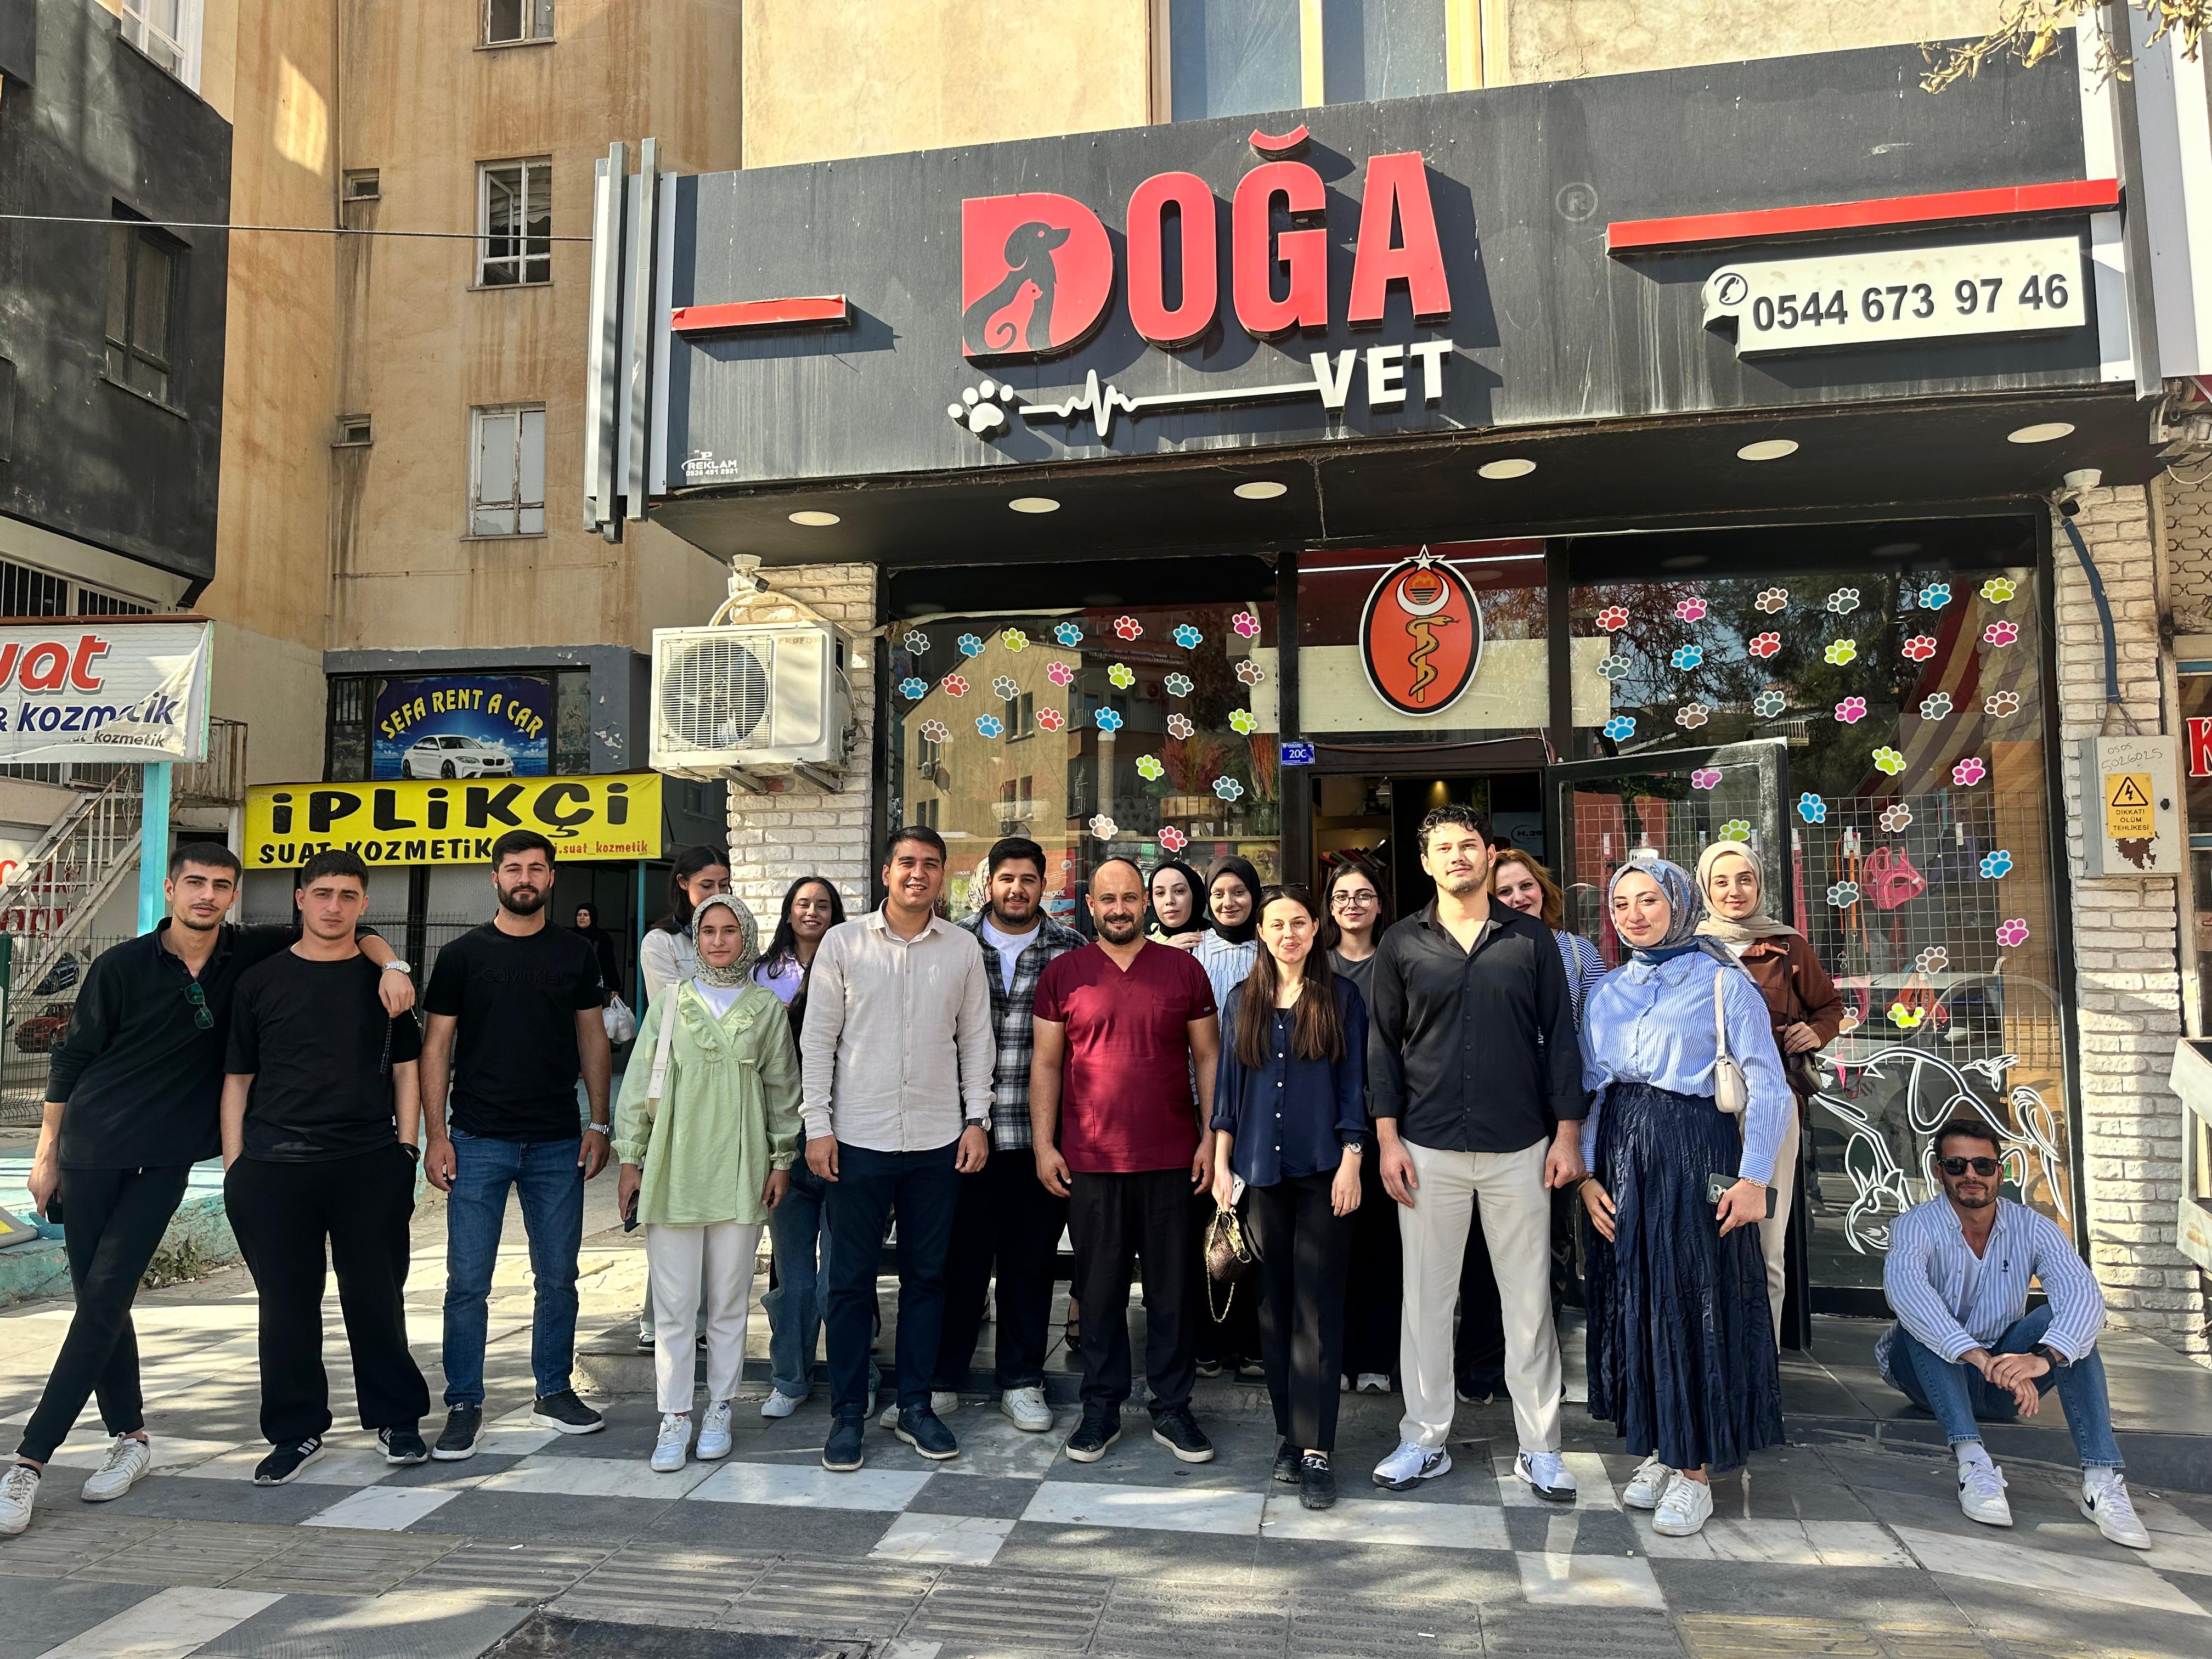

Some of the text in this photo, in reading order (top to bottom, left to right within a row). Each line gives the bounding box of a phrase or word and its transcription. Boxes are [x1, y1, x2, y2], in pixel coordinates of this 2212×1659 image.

[962, 124, 1452, 359] DOĞA
[1753, 273, 2069, 332] 0544 673 97 46
[1310, 340, 1453, 411] VET
[687, 460, 737, 471] REKLAM
[381, 689, 544, 740] SEFA RENT A CAR
[1289, 749, 1307, 759] 20C
[258, 842, 332, 864] SUAT
[1042, 889, 1066, 898] NIQUE
[482, 966, 531, 983] Calvin
